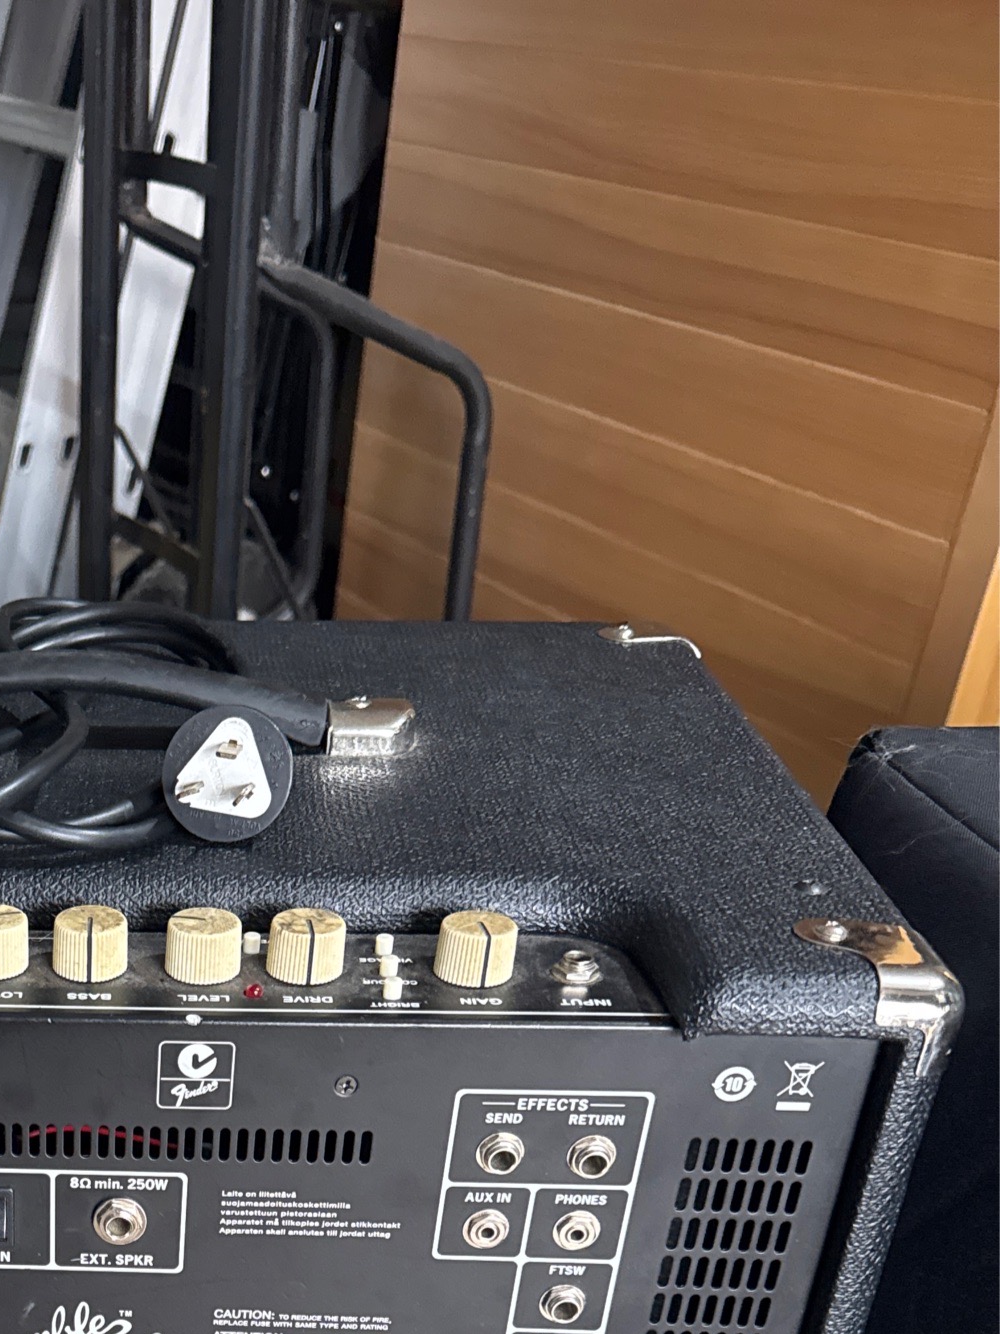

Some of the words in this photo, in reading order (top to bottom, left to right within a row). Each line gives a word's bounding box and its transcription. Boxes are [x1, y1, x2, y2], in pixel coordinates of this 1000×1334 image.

[67, 992, 112, 1001] BASS
[177, 994, 230, 1002] LEVEL
[282, 996, 333, 1004] DRIVE
[460, 997, 503, 1006] GAIN
[560, 998, 612, 1007] INPUT
[725, 1076, 743, 1092] 10
[517, 1098, 589, 1113] EFFECTS
[485, 1113, 523, 1124] SEND
[568, 1114, 625, 1126] RETURN
[69, 1177, 92, 1190] 8Ω
[95, 1178, 123, 1190] min.
[127, 1178, 168, 1190] 250W
[465, 1192, 494, 1203] AUX
[496, 1193, 512, 1203] IN
[554, 1194, 607, 1205] PHONES
[80, 1253, 112, 1266] EXT.
[115, 1253, 154, 1266] SPKR
[548, 1266, 586, 1276] FTSW
[213, 1309, 275, 1320] CAUTION:
[291, 1314, 322, 1322] REDUCE
[340, 1315, 358, 1323] RISK
[372, 1316, 392, 1324] FIRE,
[213, 1319, 248, 1327] REPLACE
[295, 1321, 317, 1329] SAME
